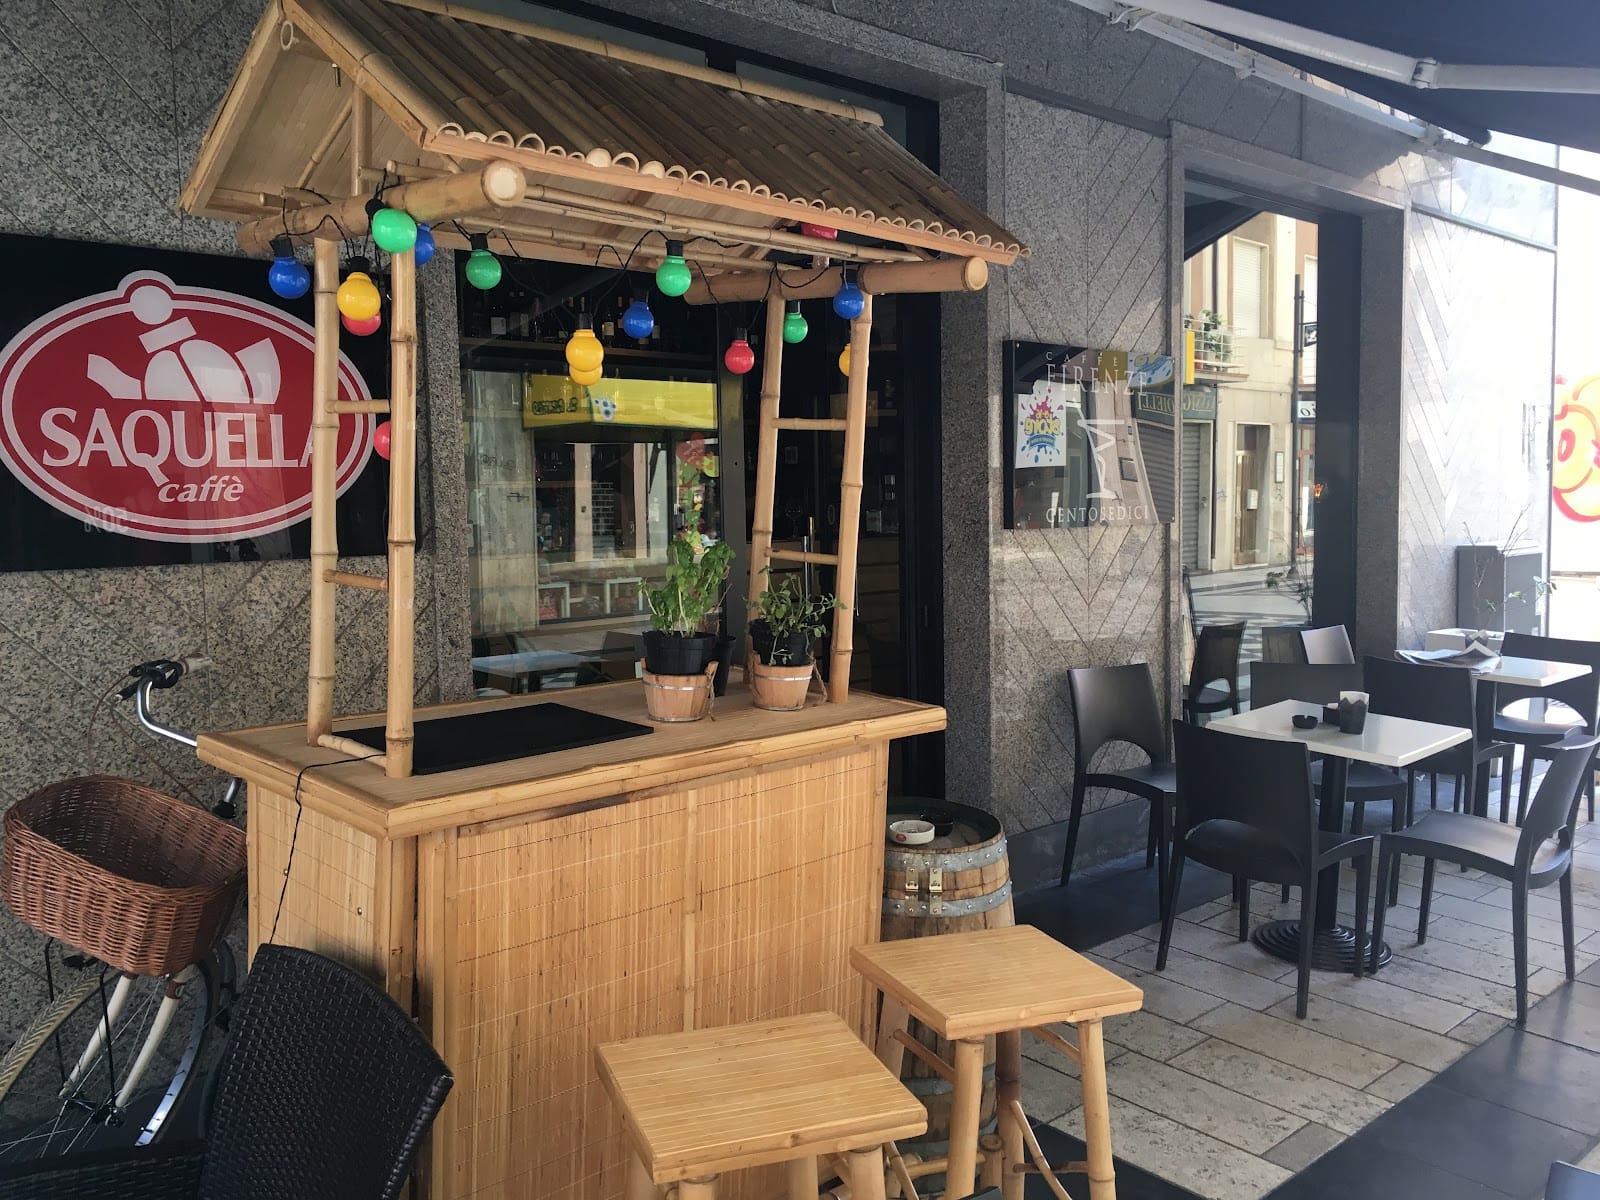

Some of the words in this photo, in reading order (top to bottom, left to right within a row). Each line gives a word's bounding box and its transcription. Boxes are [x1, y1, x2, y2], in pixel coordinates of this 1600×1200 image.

[1046, 363, 1148, 396] FIRENZE
[158, 475, 245, 503] caffè
[1046, 504, 1148, 523] CENTOSEDICI
